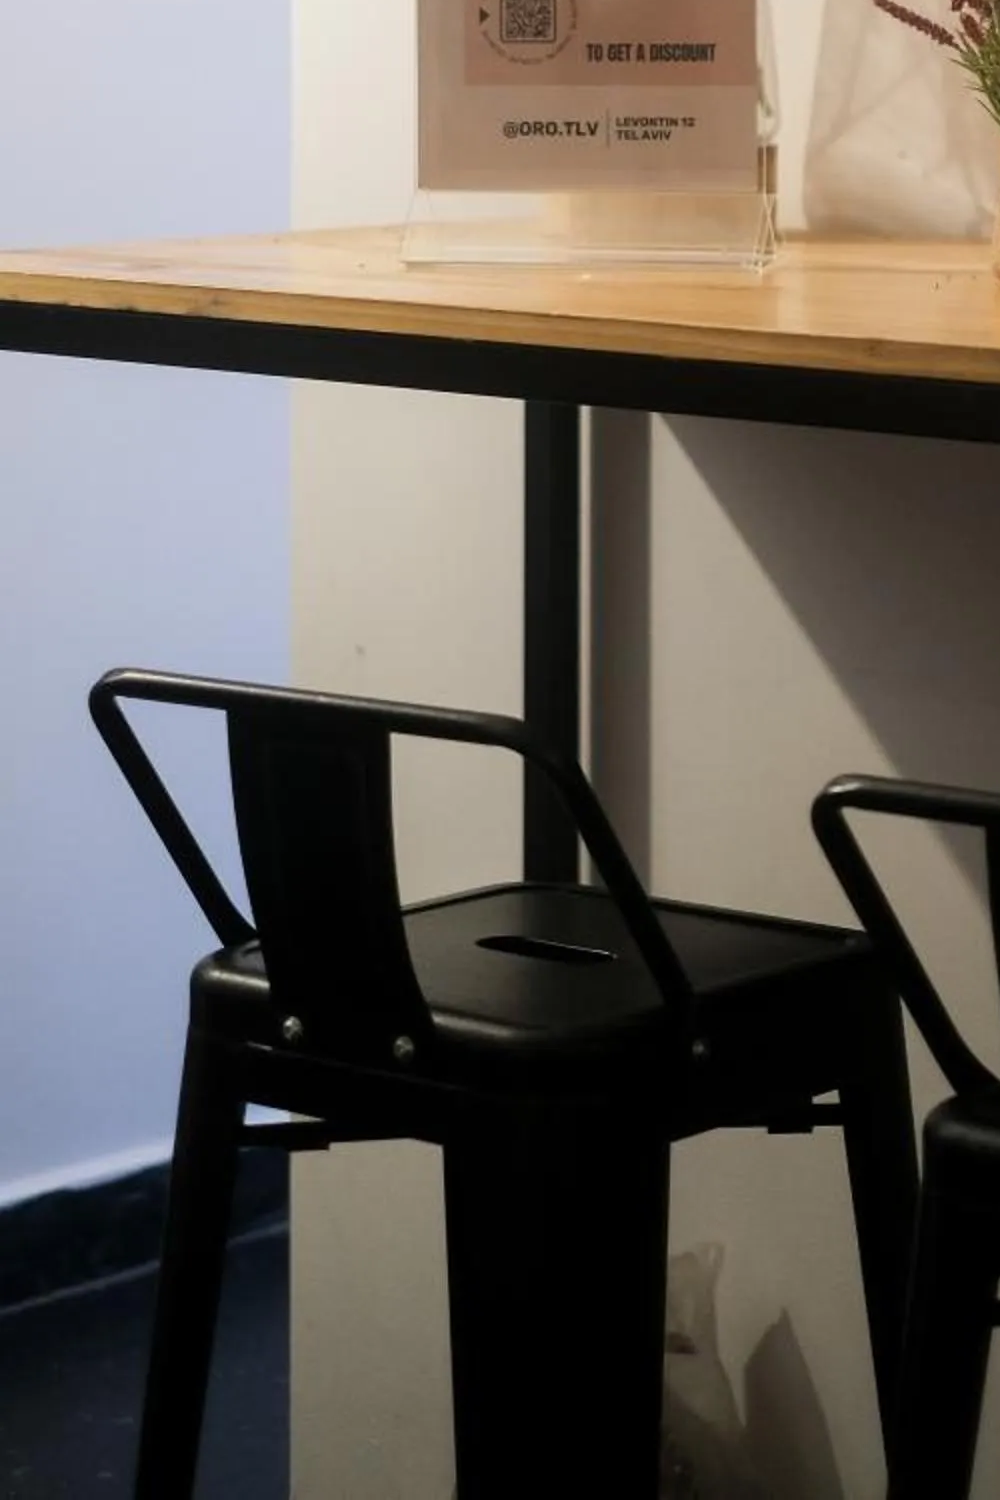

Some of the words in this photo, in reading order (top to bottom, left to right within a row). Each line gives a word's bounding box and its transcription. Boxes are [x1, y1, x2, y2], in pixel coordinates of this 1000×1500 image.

[585, 43, 603, 62] TO
[607, 43, 632, 62] GET
[636, 43, 645, 62] A
[649, 43, 717, 62] DISCOUNT
[615, 116, 679, 127] LEVONTIN
[503, 121, 599, 138] @ORO.TLV
[616, 130, 640, 141] TEL
[641, 130, 672, 141] AVIV
